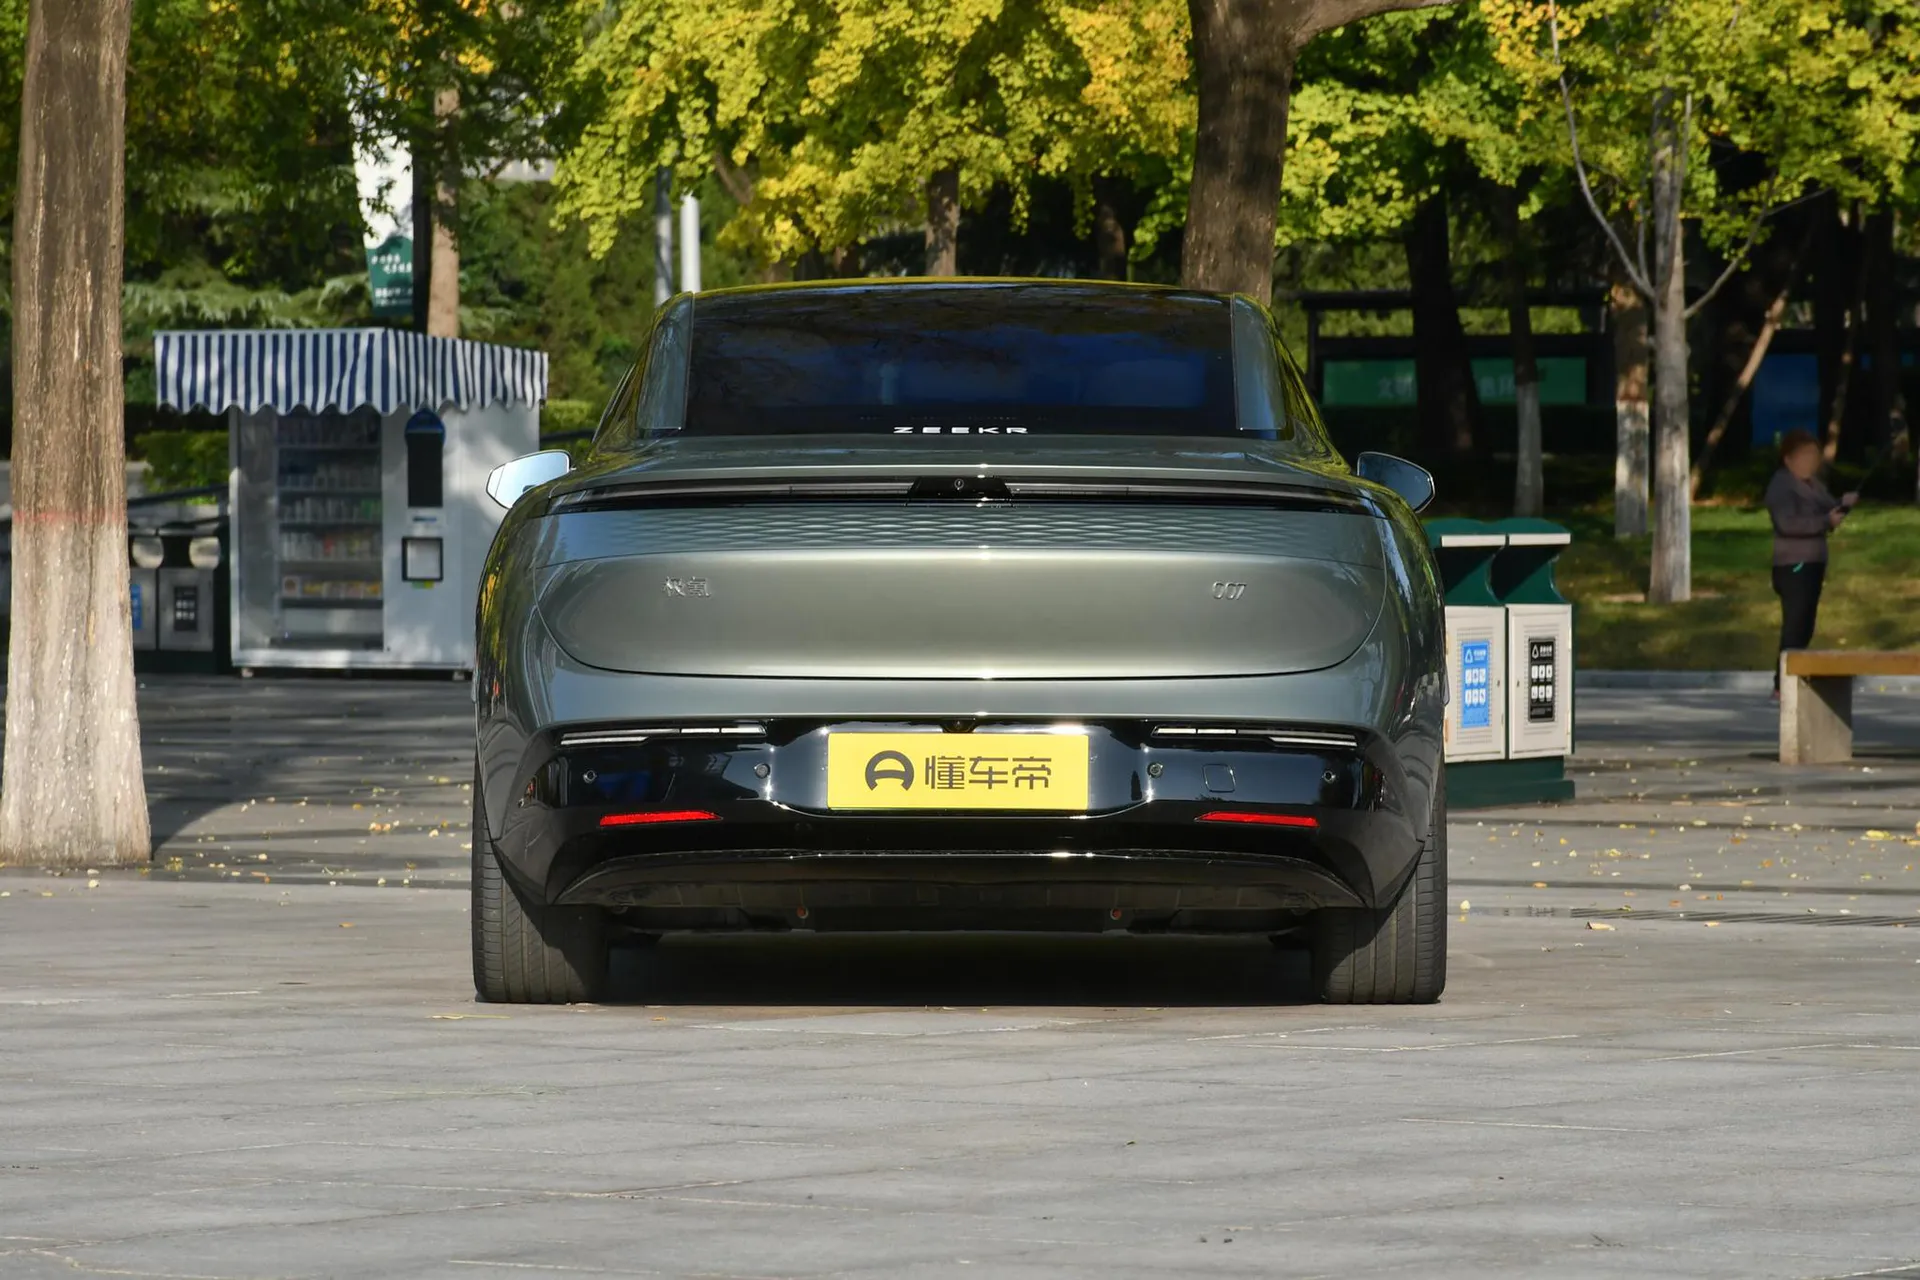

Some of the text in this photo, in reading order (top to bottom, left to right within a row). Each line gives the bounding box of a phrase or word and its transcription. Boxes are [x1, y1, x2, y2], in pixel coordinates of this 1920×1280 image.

[893, 426, 1028, 434] ZEEKR
[1211, 581, 1247, 600] 007
[925, 755, 1052, 790] 懂车帝
